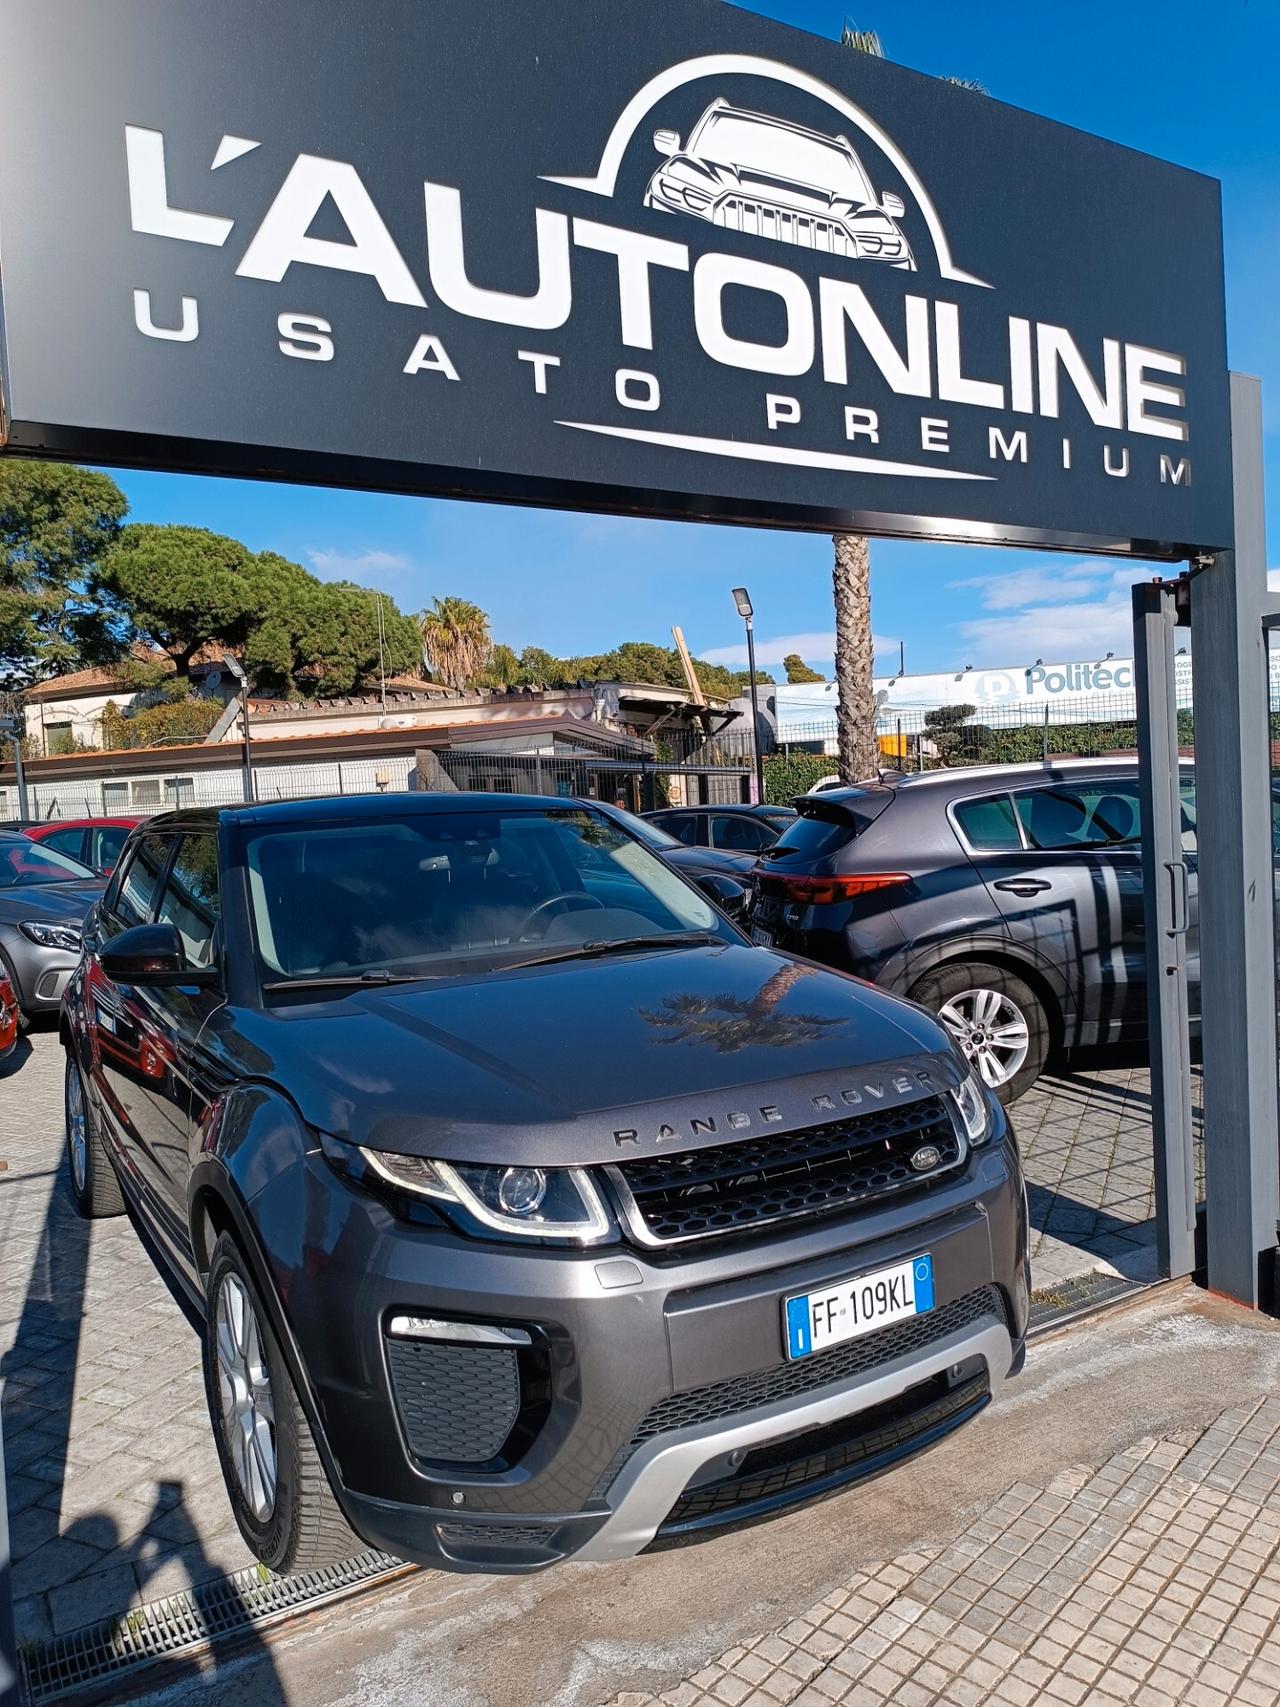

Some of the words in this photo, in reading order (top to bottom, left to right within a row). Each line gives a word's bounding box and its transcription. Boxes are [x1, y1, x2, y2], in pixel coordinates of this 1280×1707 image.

[125, 123, 1187, 441] L'AUTONLINE
[134, 288, 661, 412] USATO
[766, 393, 1192, 487] PREMIUM
[612, 1104, 783, 1148] RANGE
[810, 1070, 935, 1112] ROVER
[812, 1296, 839, 1339] FF
[849, 1274, 915, 1325] 109KL
